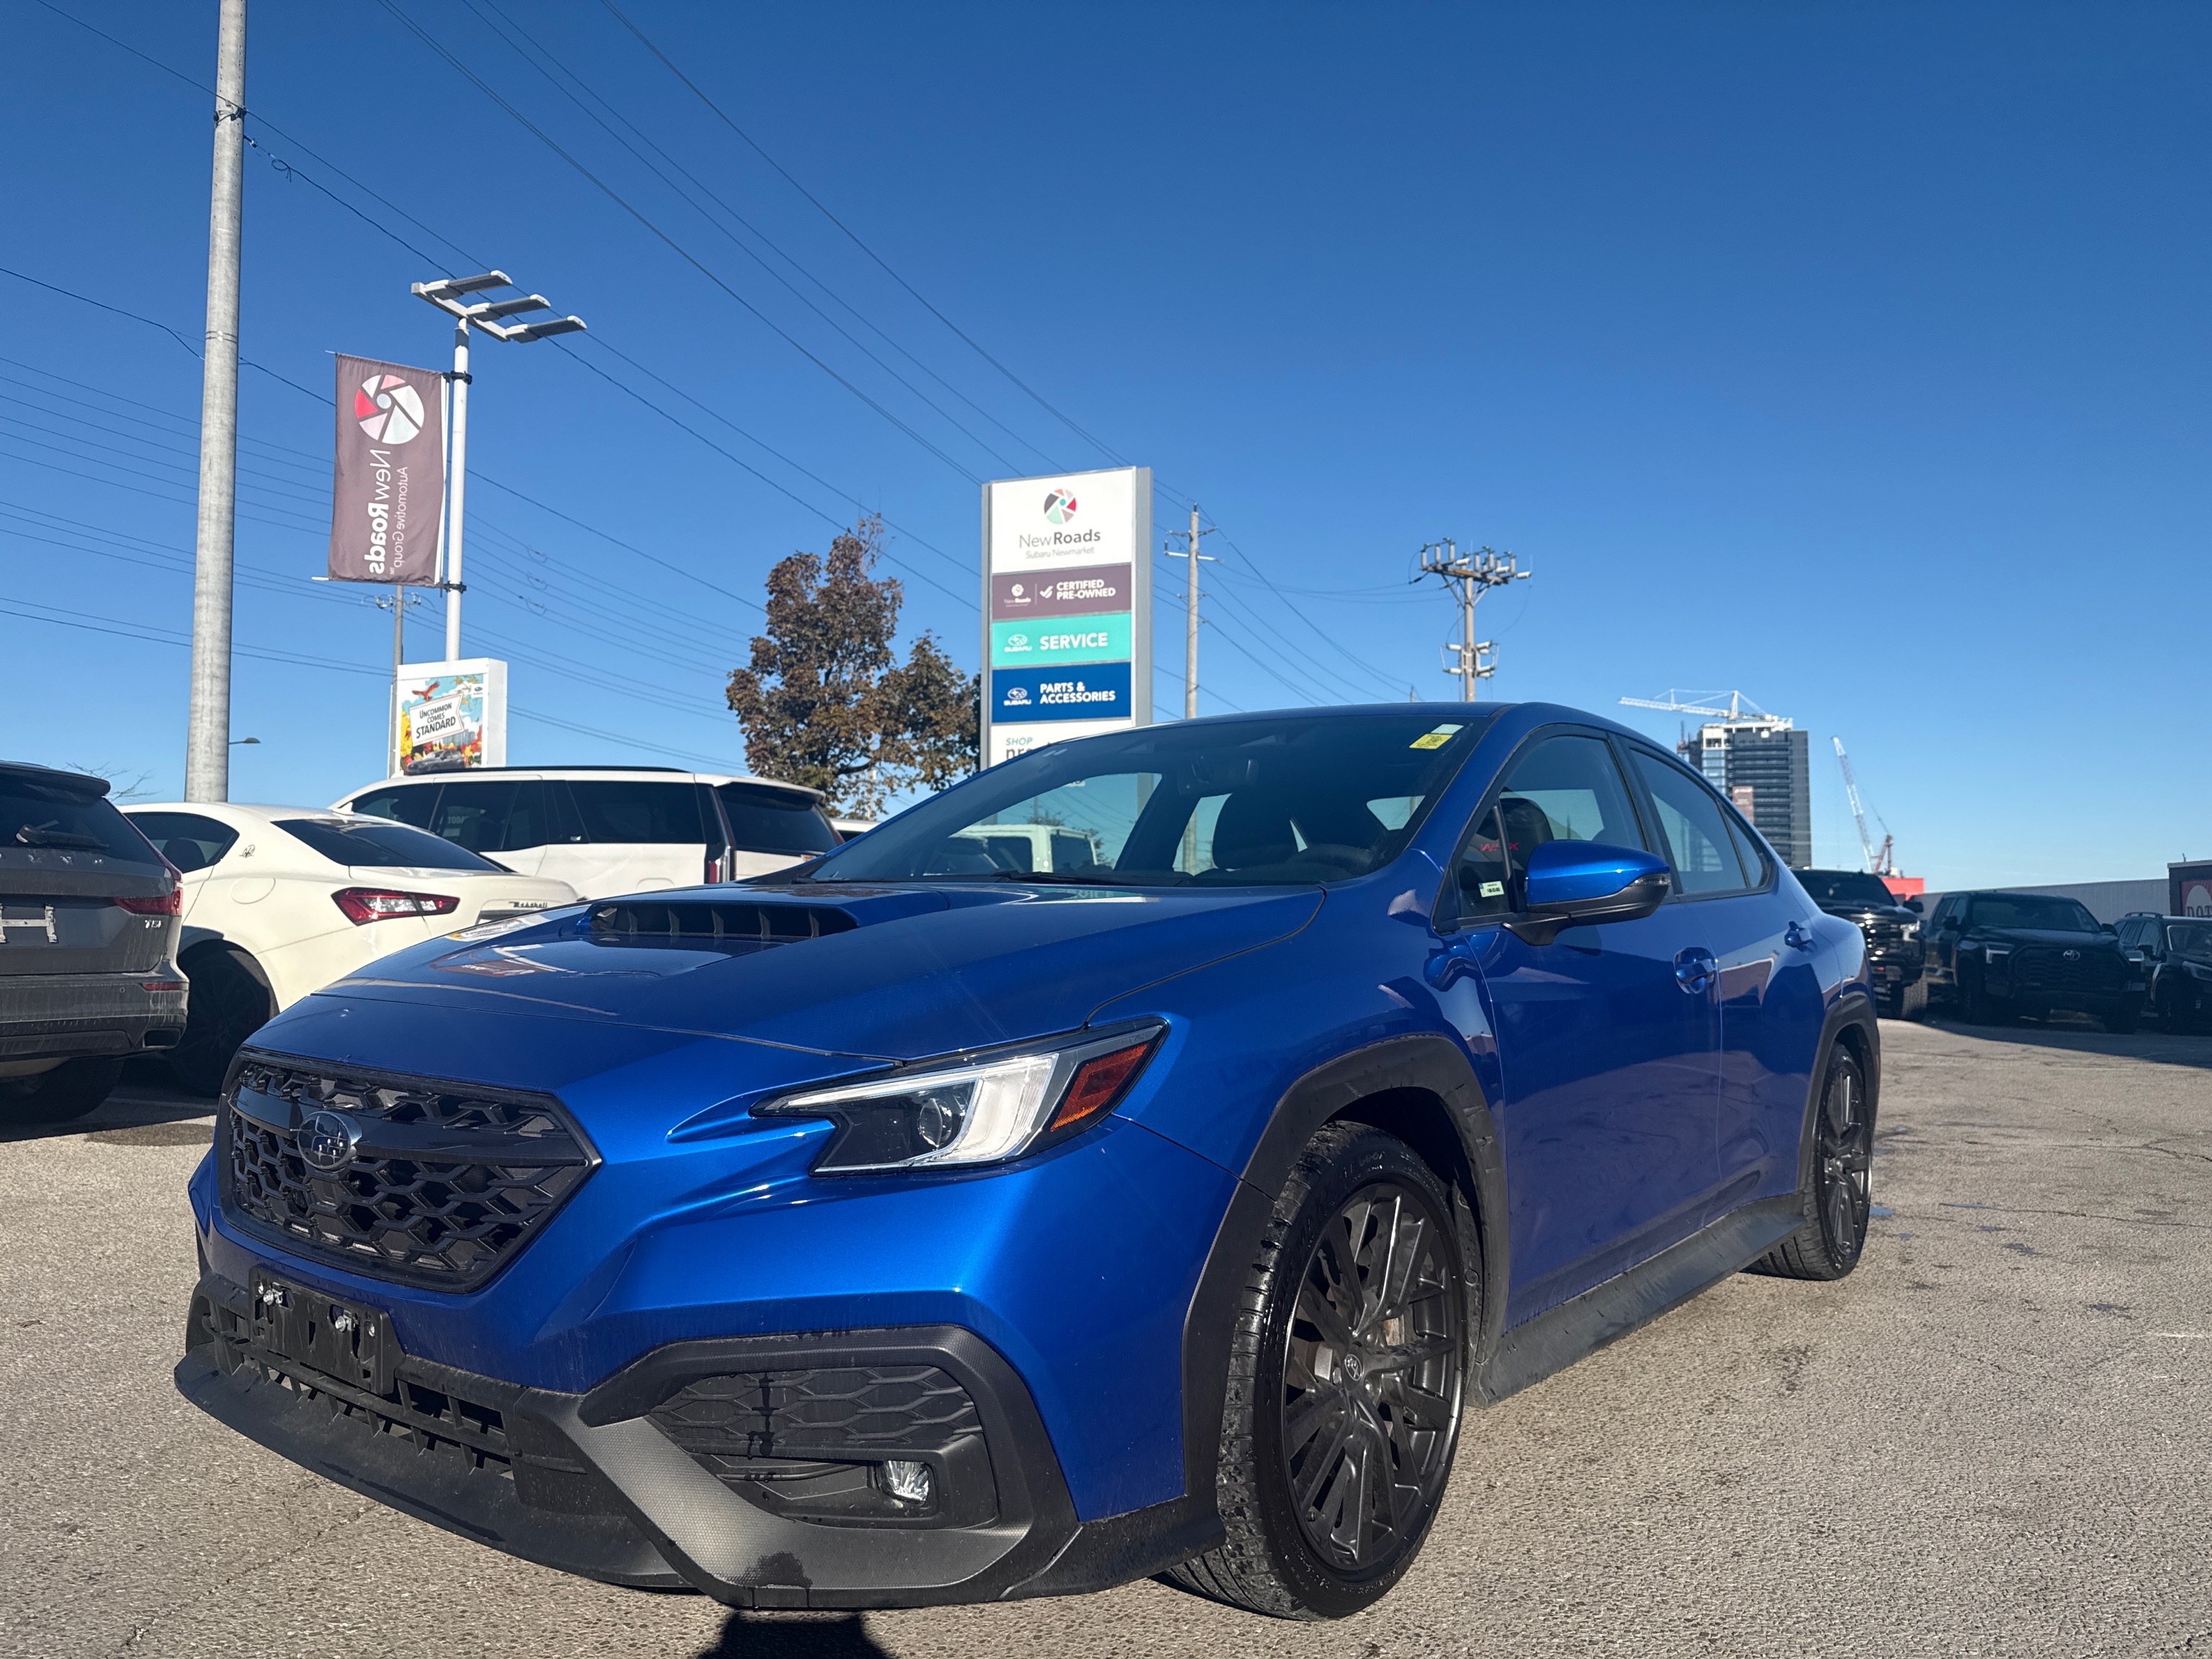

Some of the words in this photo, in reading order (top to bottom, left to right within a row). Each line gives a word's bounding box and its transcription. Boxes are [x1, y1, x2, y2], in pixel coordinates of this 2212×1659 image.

[1026, 550, 1051, 559] Subaru
[1052, 547, 1094, 557] Newmarket
[1056, 579, 1105, 591] CERTIFIED
[1056, 587, 1116, 600] PRE-OWNED
[1040, 632, 1108, 650] SERVICE
[1040, 683, 1074, 693] PARTS
[1076, 681, 1085, 691] &
[1040, 691, 1116, 704] ACCESSORIES
[419, 703, 452, 719] UNCOMMON
[427, 712, 445, 724] COMES
[416, 716, 456, 739] STANDARD
[1005, 737, 1033, 746] SHOP
